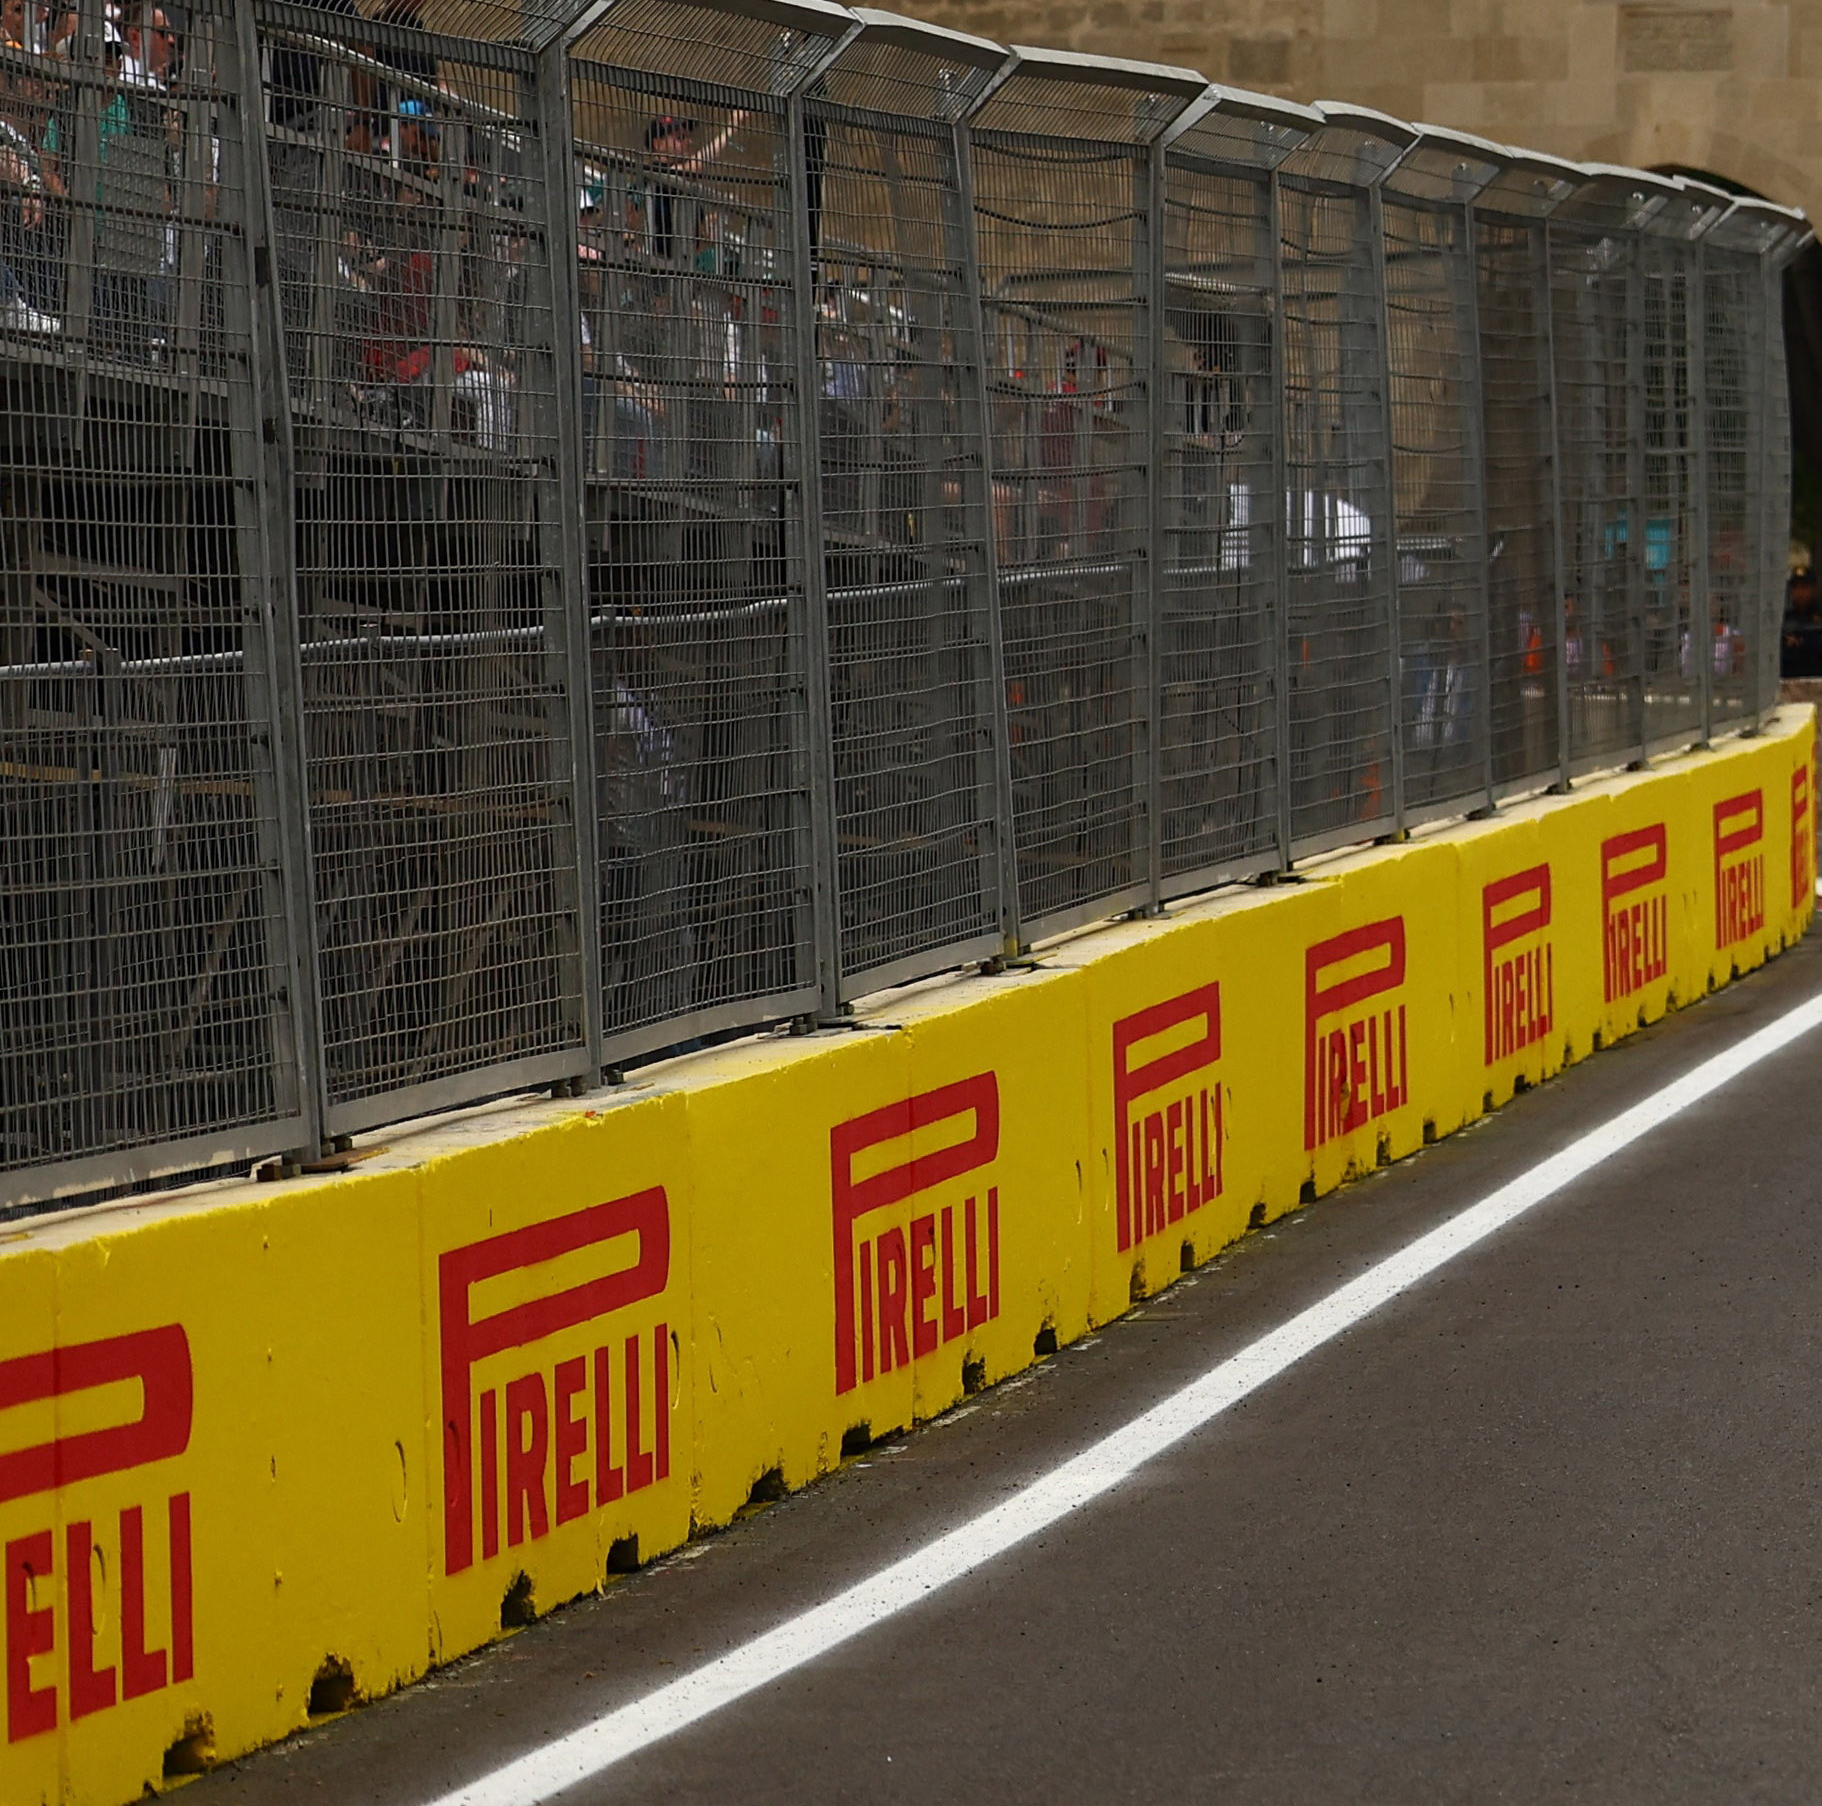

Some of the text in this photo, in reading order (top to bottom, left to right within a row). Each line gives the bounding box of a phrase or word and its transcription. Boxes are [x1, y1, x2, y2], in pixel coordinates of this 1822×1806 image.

[1482, 863, 1554, 1067] PIRELLI
[1601, 823, 1667, 1003] PIRELLI
[1713, 788, 1764, 950] PIRELLI
[1112, 980, 1224, 1254] PIRELLI
[1303, 915, 1408, 1151] PIRELLI
[830, 1069, 1000, 1397] PIRELLI
[439, 1184, 670, 1577] PIRELLI
